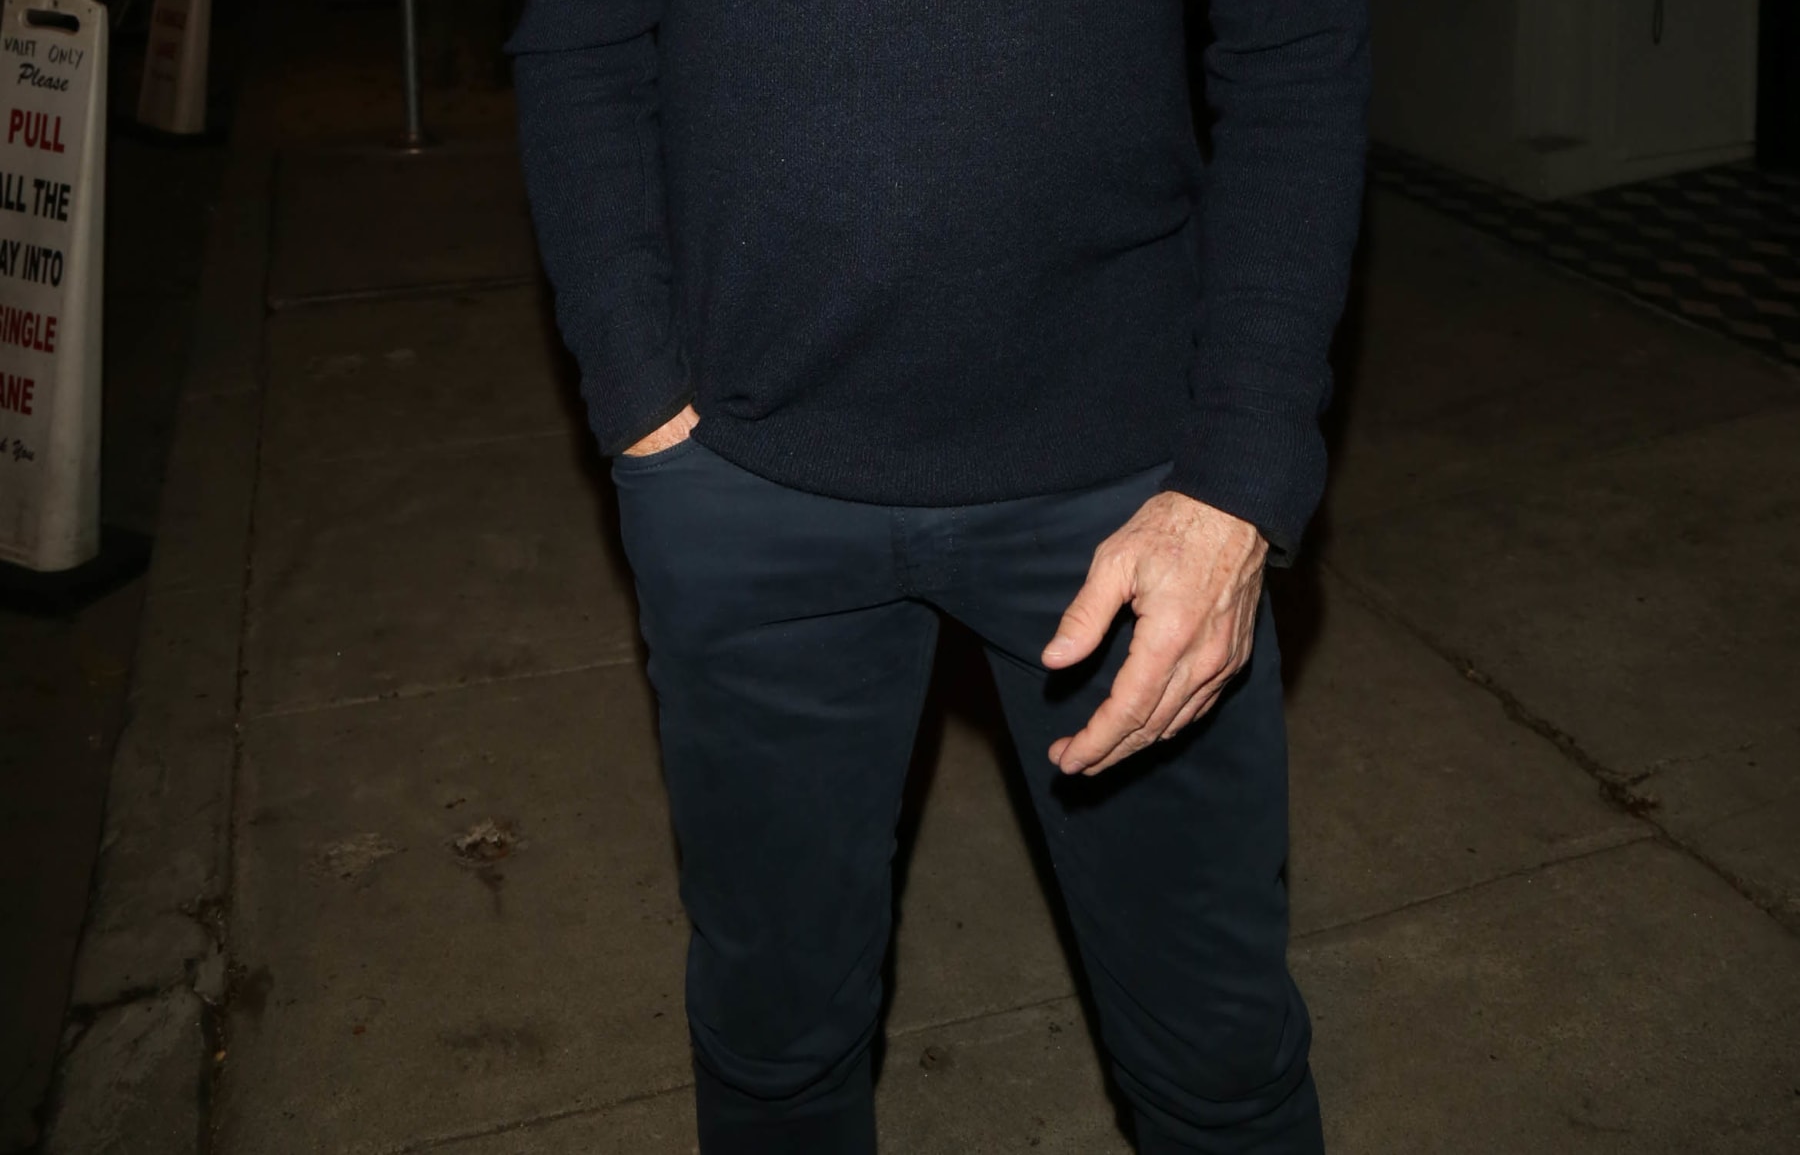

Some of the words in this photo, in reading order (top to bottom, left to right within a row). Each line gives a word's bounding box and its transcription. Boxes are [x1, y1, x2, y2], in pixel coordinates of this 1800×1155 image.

[17, 63, 69, 92] Please
[48, 44, 84, 70] ONLY
[8, 108, 65, 153] PULL
[33, 178, 71, 222] THE
[0, 239, 20, 277] AY
[22, 243, 64, 286] INTO
[0, 372, 35, 415] ANE
[12, 439, 35, 463] You
